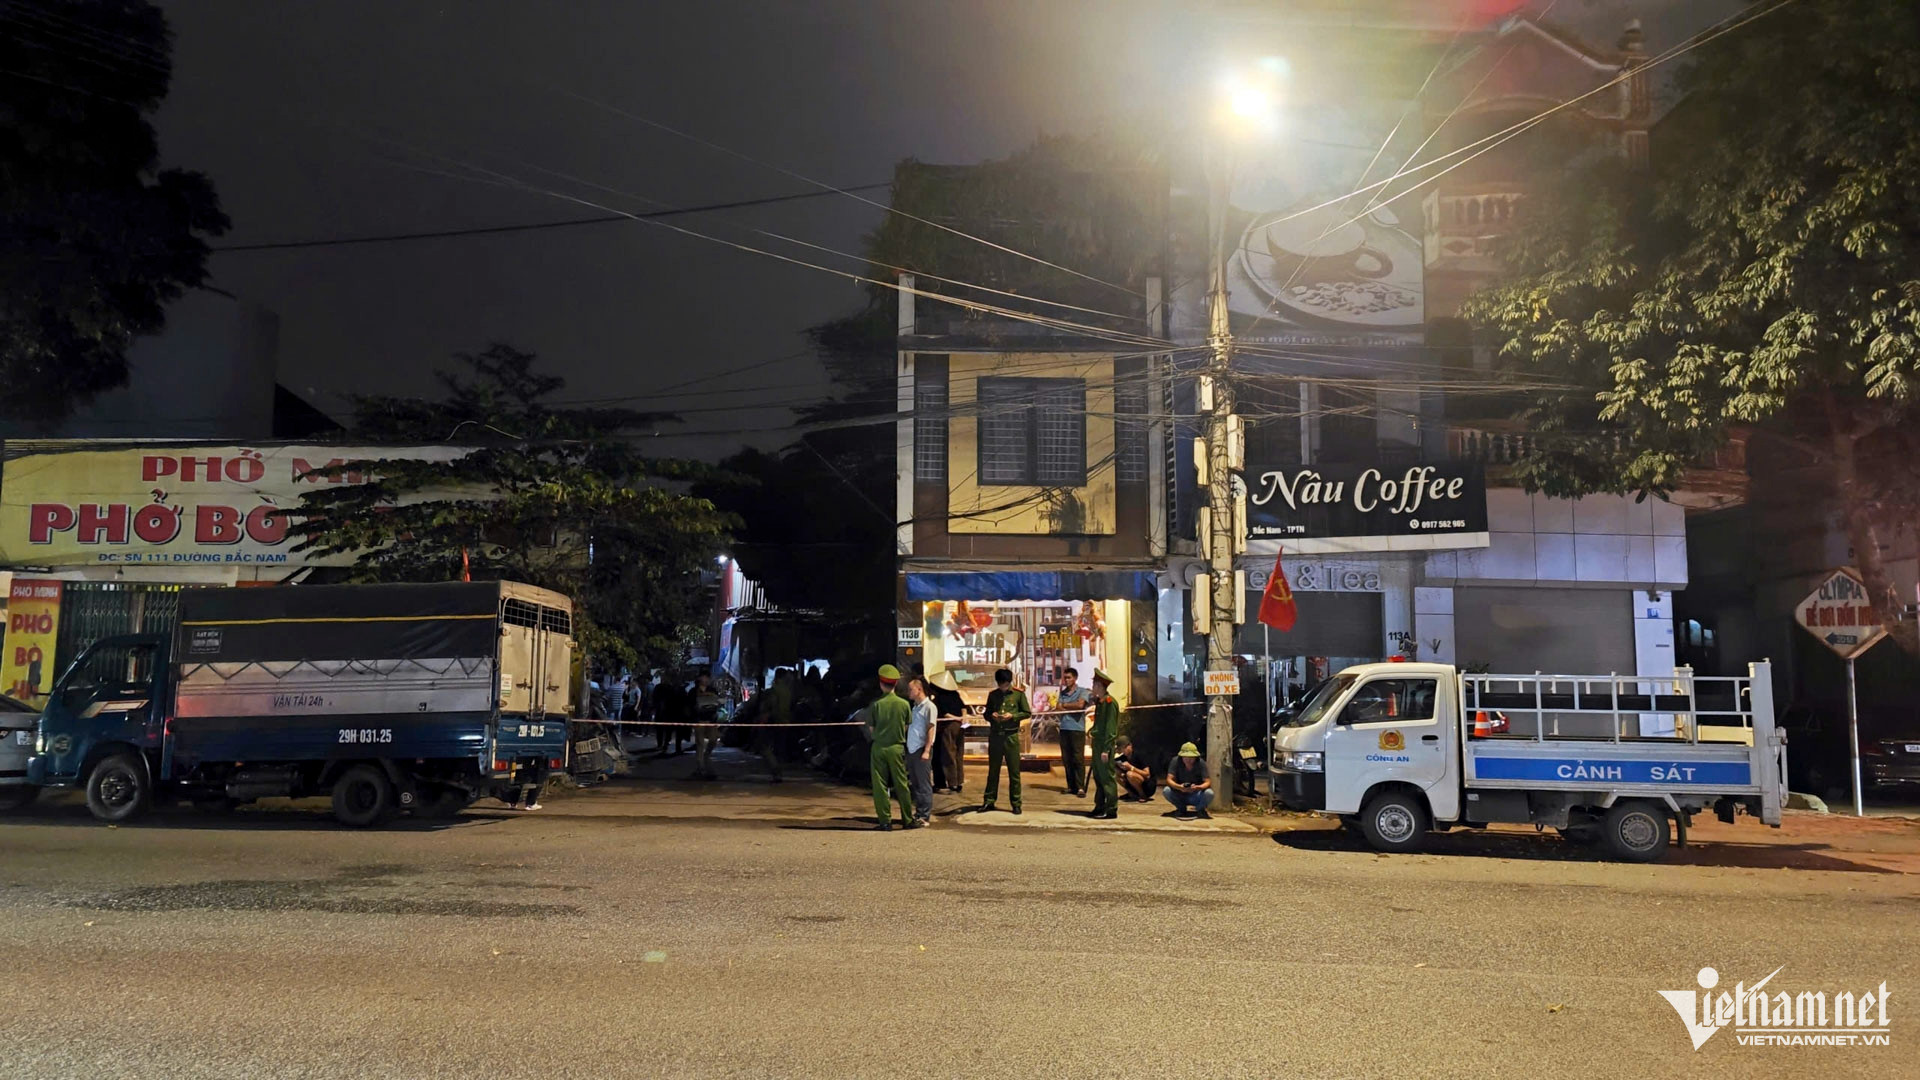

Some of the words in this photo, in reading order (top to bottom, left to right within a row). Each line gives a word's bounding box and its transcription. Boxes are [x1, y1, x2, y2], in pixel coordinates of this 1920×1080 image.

[1251, 469, 1345, 511] Nâu
[1353, 465, 1464, 515] Coffee
[29, 489, 184, 545] PHỞ
[195, 495, 292, 545] BÒ
[1287, 525, 1305, 534] TPTN
[124, 553, 142, 562] SN
[147, 554, 168, 562] 111
[256, 554, 287, 562] NAM
[901, 629, 920, 640] 113B
[1388, 631, 1411, 641] 113A
[1209, 672, 1235, 683] KHÔNG
[1223, 684, 1238, 694] XE
[1396, 755, 1410, 763] AN
[1556, 759, 1622, 780] CẢNH
[1650, 762, 1697, 781] SÁT
